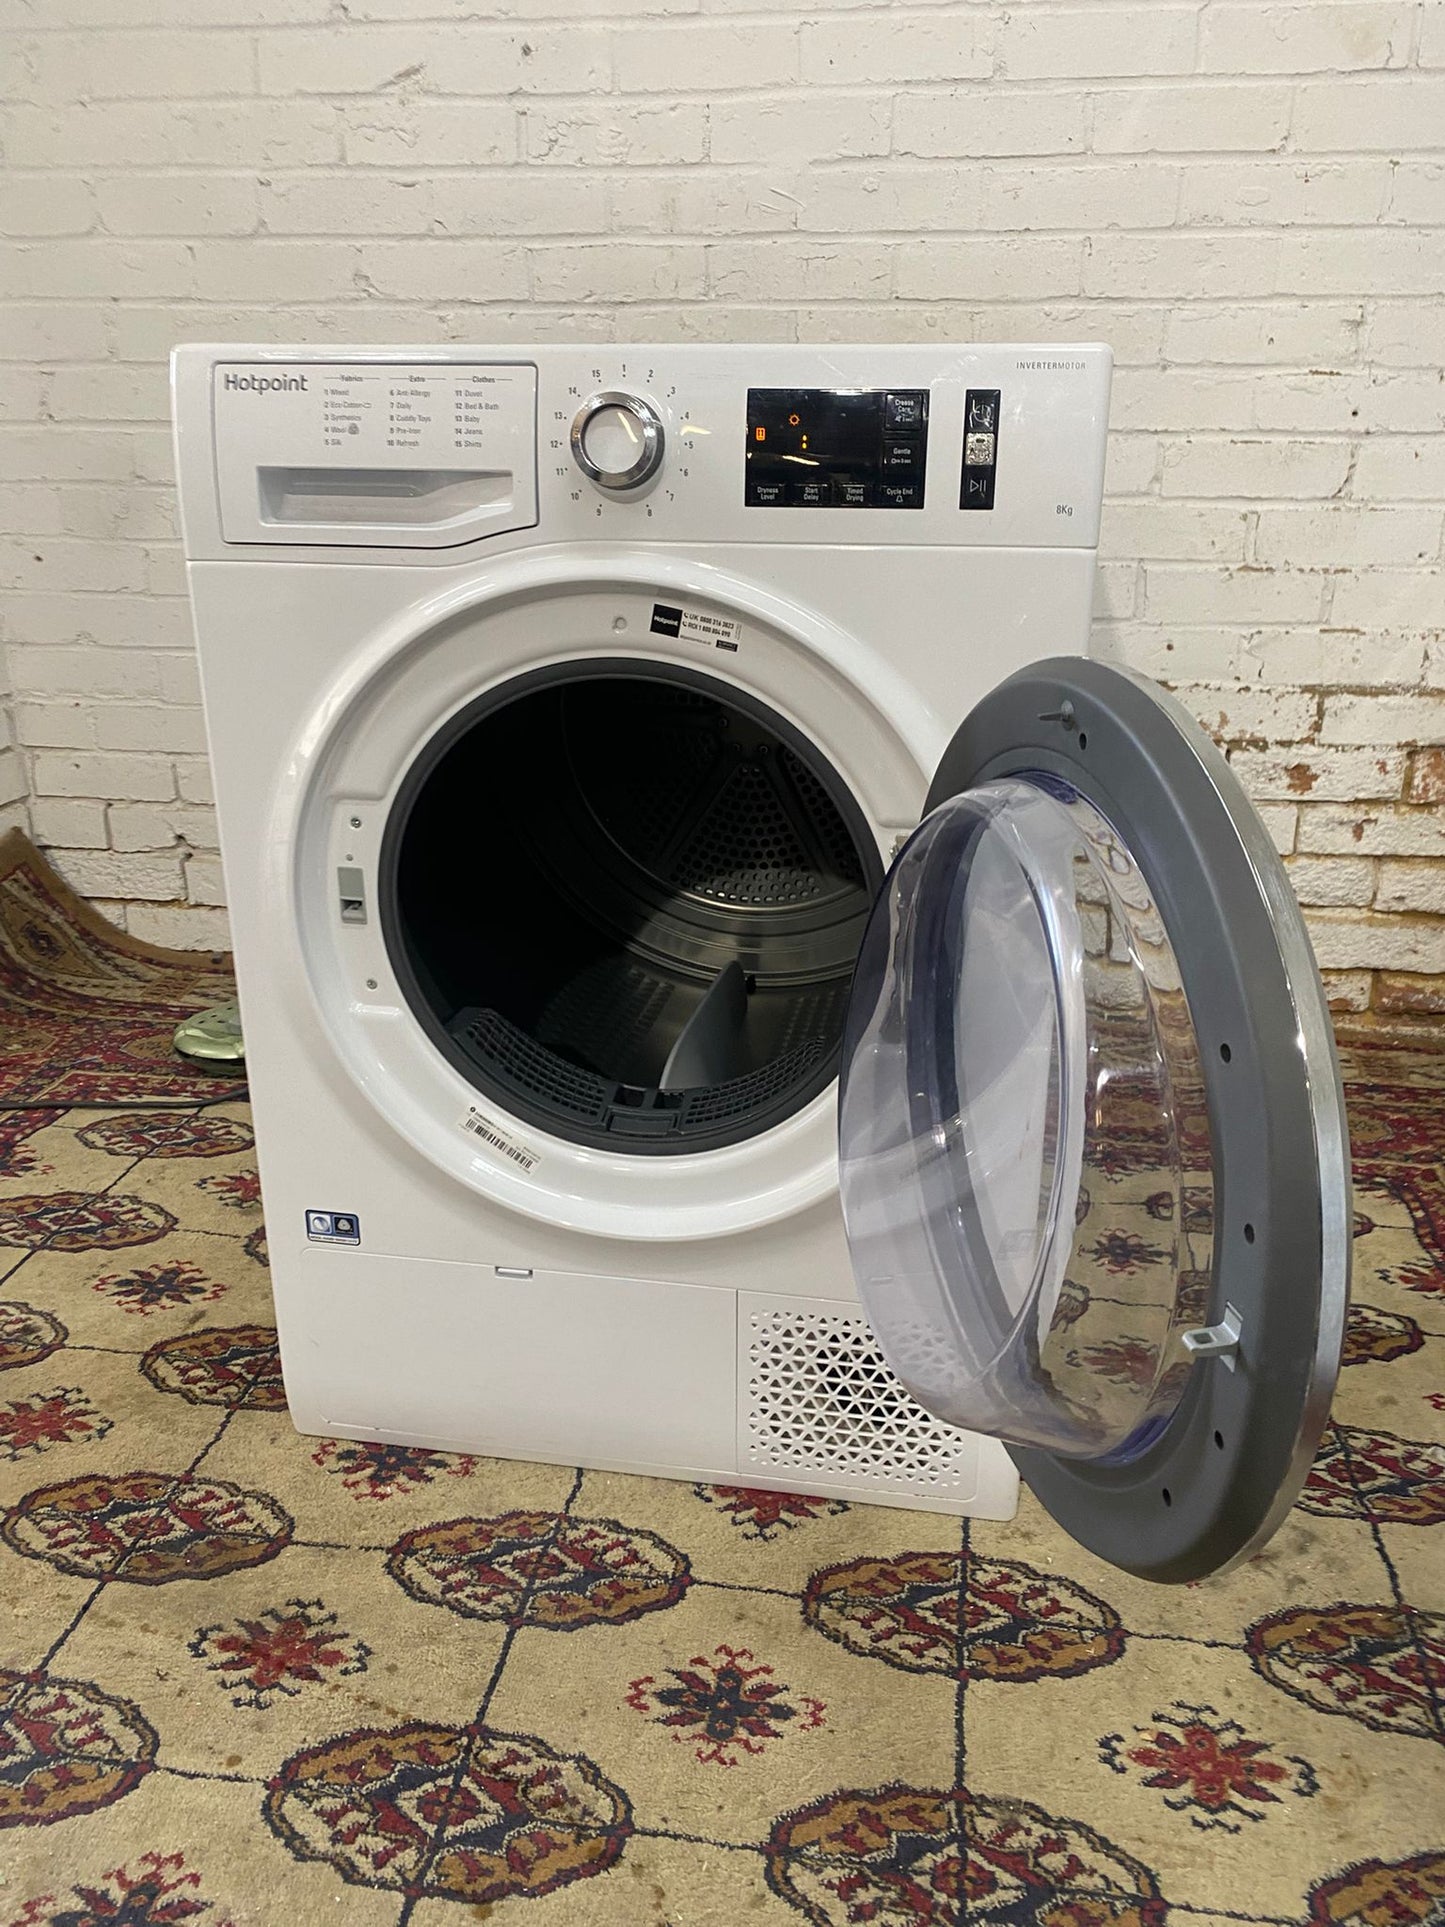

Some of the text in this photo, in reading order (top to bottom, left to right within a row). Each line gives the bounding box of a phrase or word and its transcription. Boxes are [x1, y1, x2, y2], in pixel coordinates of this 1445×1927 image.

[622, 364, 626, 373] 1
[1016, 362, 1086, 370] INVERTERMOTOR
[224, 373, 308, 395] Hotpoint
[568, 387, 577, 395] 14
[671, 387, 676, 395] 3
[455, 402, 463, 410] 12
[464, 415, 480, 423] Baby
[554, 412, 563, 420] 13
[684, 412, 690, 420] 4
[455, 440, 482, 448] 15 Shirts
[550, 440, 559, 448] 12
[688, 441, 694, 449] 5
[556, 468, 564, 476] 11
[683, 468, 689, 476] 6
[757, 486, 779, 494] Dryness
[886, 487, 902, 495] Cycle
[571, 492, 580, 500] 10
[670, 493, 675, 501] 7
[803, 493, 819, 501] Delay
[846, 494, 864, 502] Drying
[597, 508, 601, 516] 9
[647, 508, 653, 516] 8
[1056, 505, 1073, 517] 8Kg
[653, 615, 679, 626] Hotpoint
